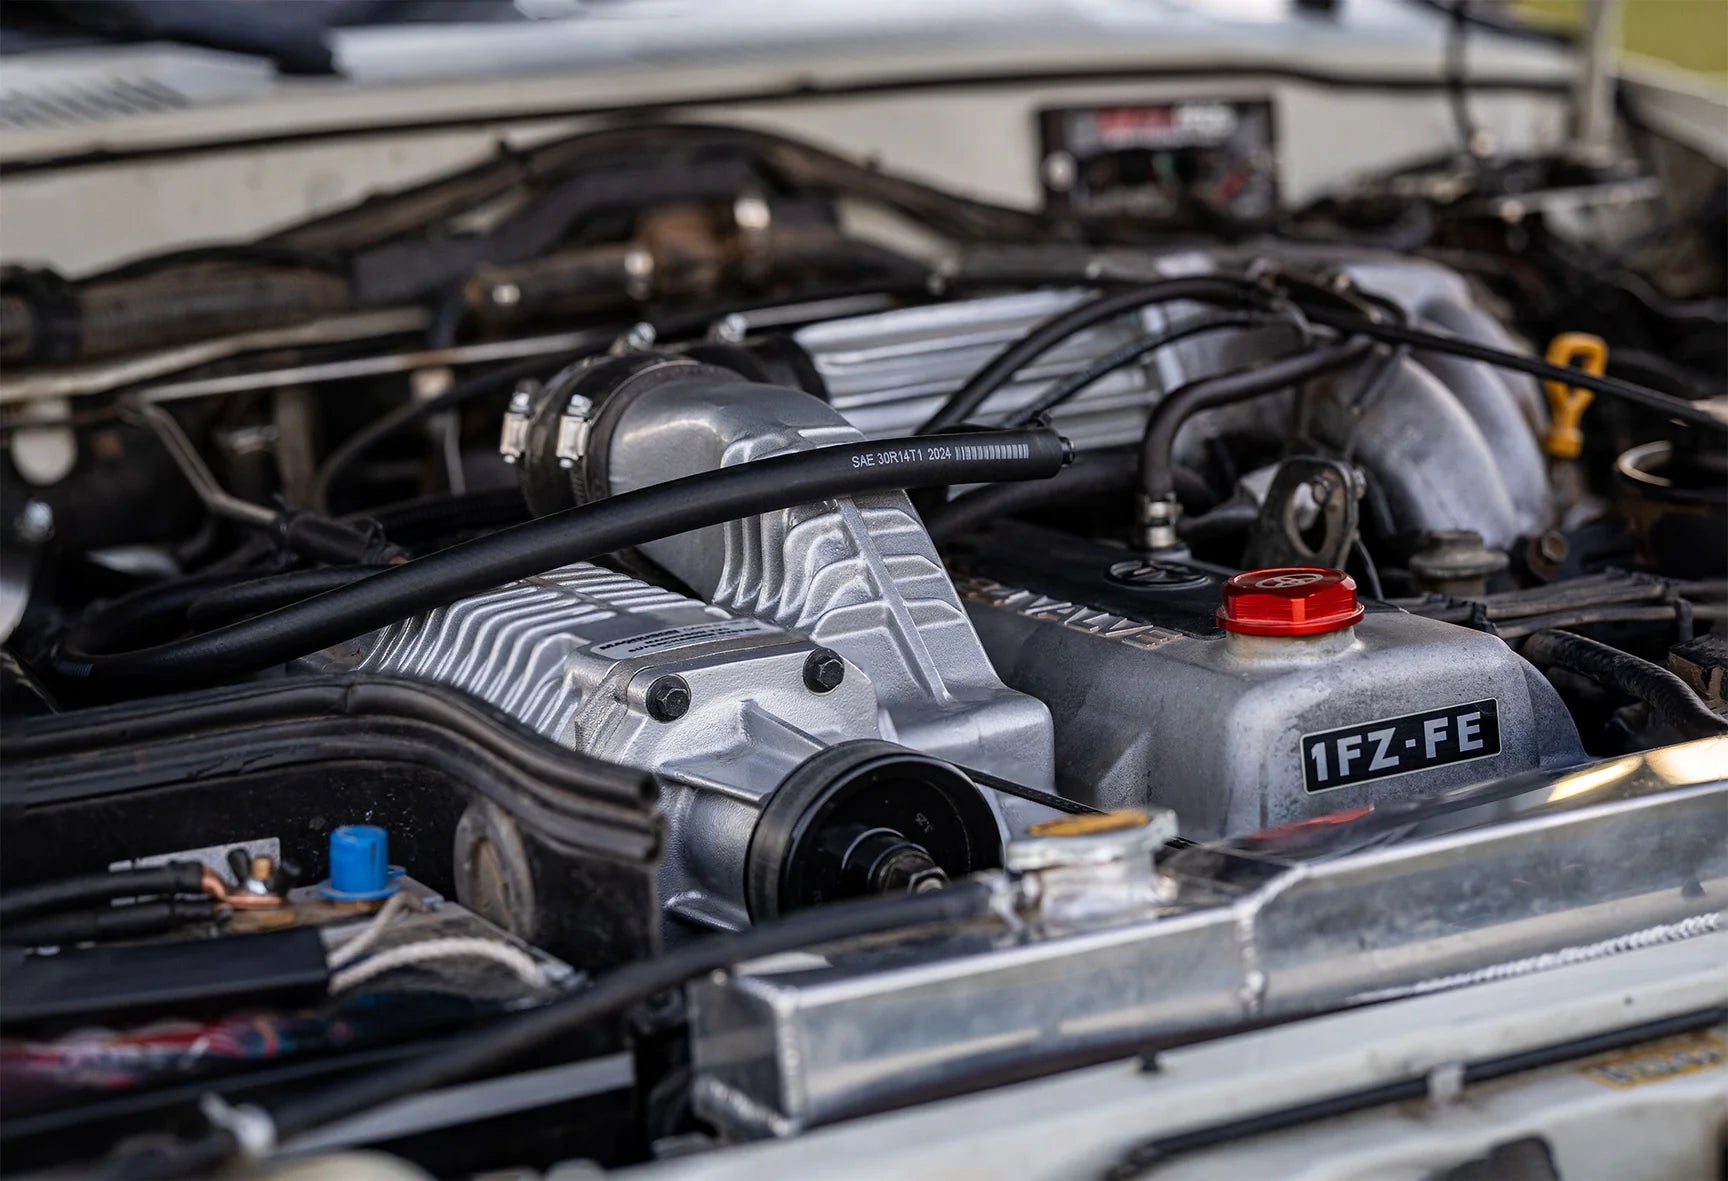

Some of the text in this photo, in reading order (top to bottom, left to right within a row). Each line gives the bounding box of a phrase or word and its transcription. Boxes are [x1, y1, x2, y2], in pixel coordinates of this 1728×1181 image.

[852, 447, 951, 468] SAE 30R14T1 2024
[1016, 594, 1184, 649] VALVE
